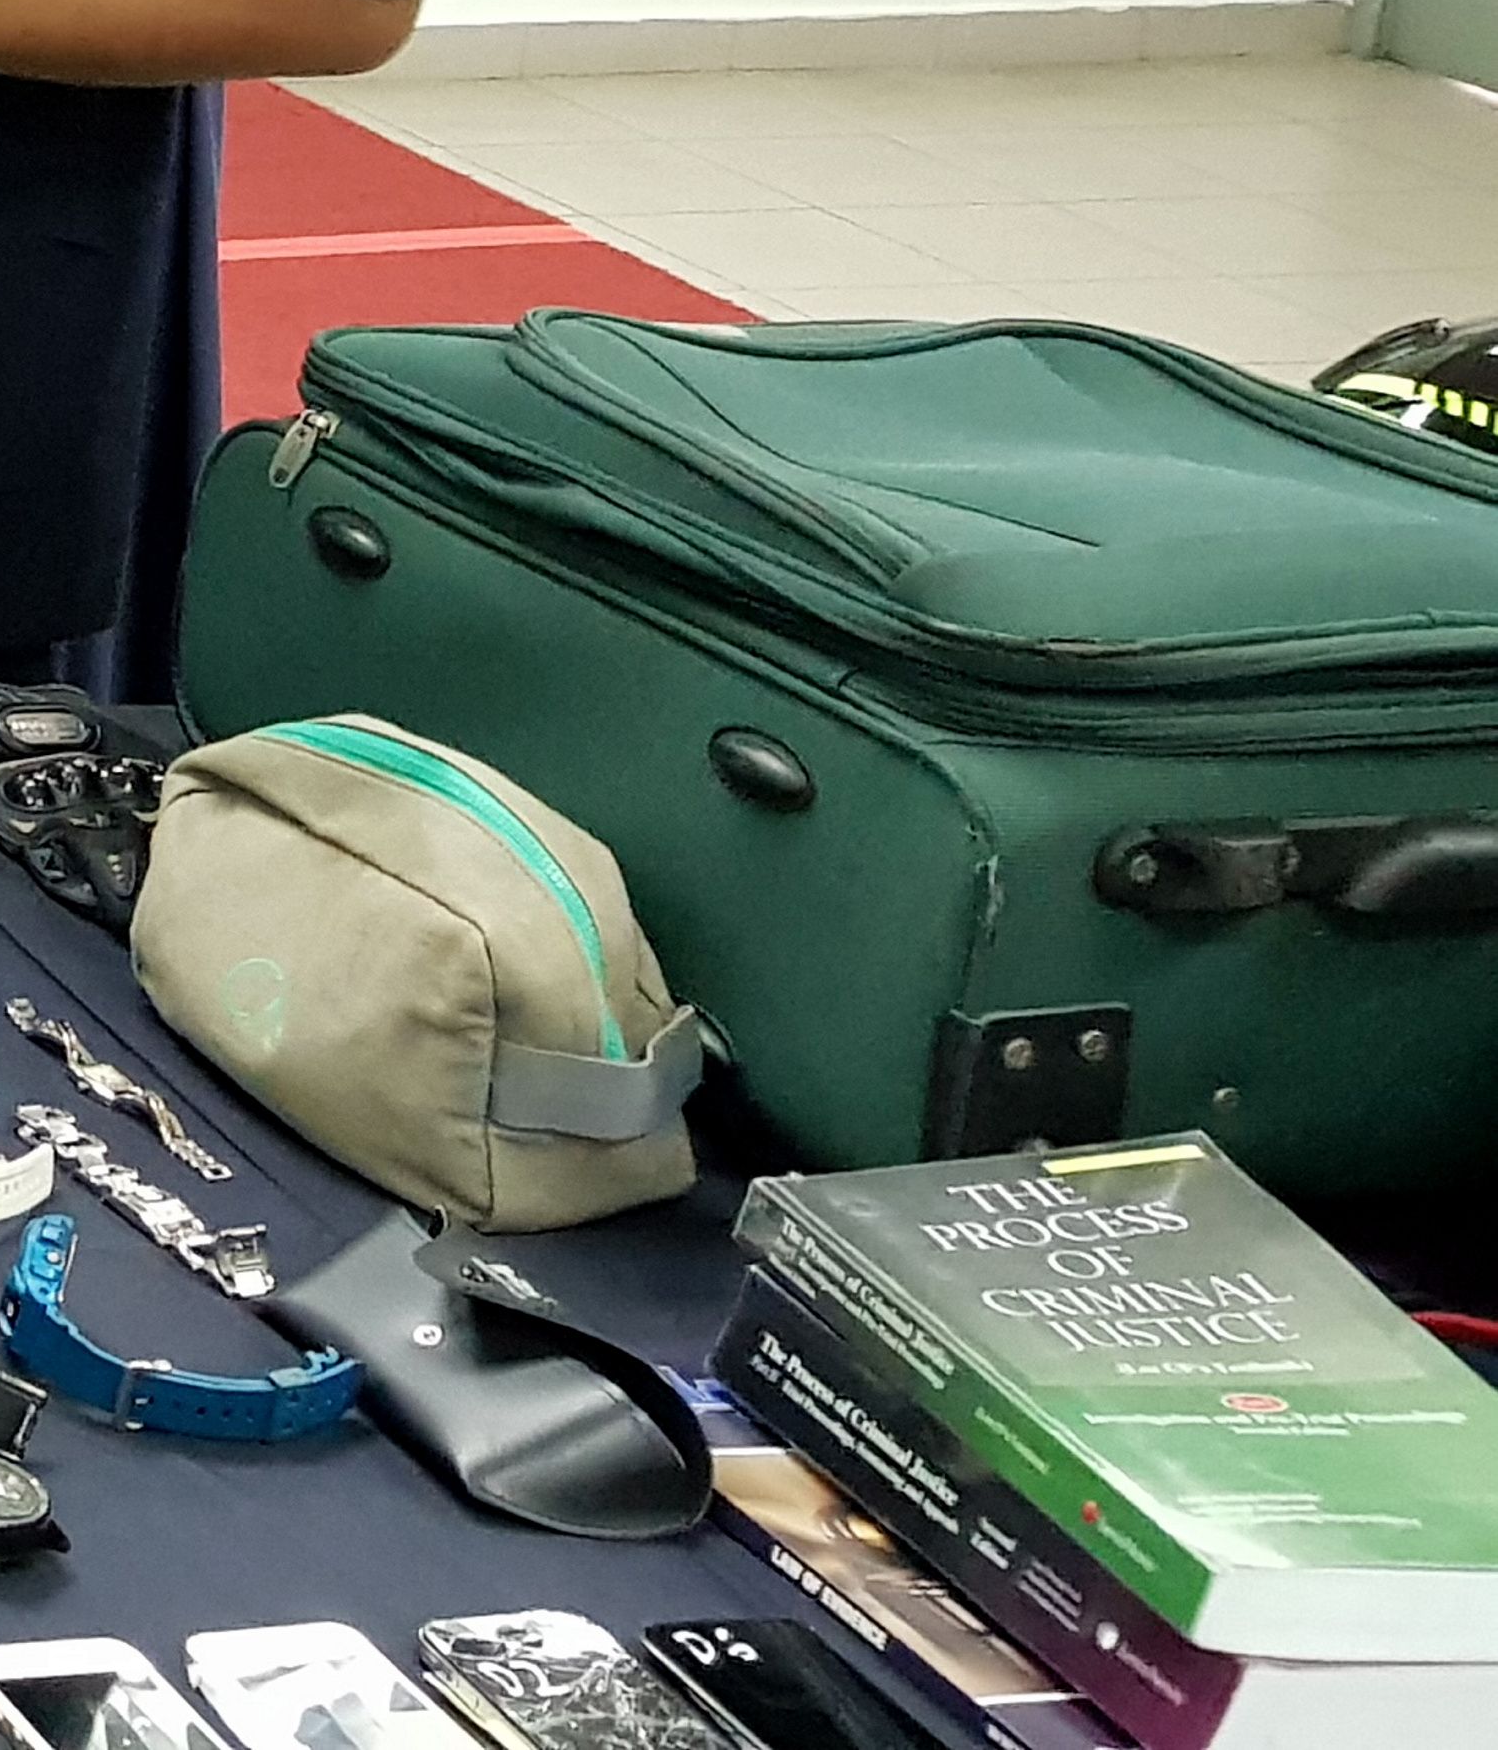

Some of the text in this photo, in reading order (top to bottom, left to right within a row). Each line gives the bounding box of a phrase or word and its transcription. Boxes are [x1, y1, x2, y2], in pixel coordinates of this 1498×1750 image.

[945, 1174, 1088, 1214] THE
[919, 1199, 1190, 1251] PROCESS
[1046, 1244, 1134, 1281] OF
[980, 1270, 1296, 1318] CRIMINAL
[759, 1330, 788, 1366] The
[1046, 1310, 1301, 1352] JUSTICE
